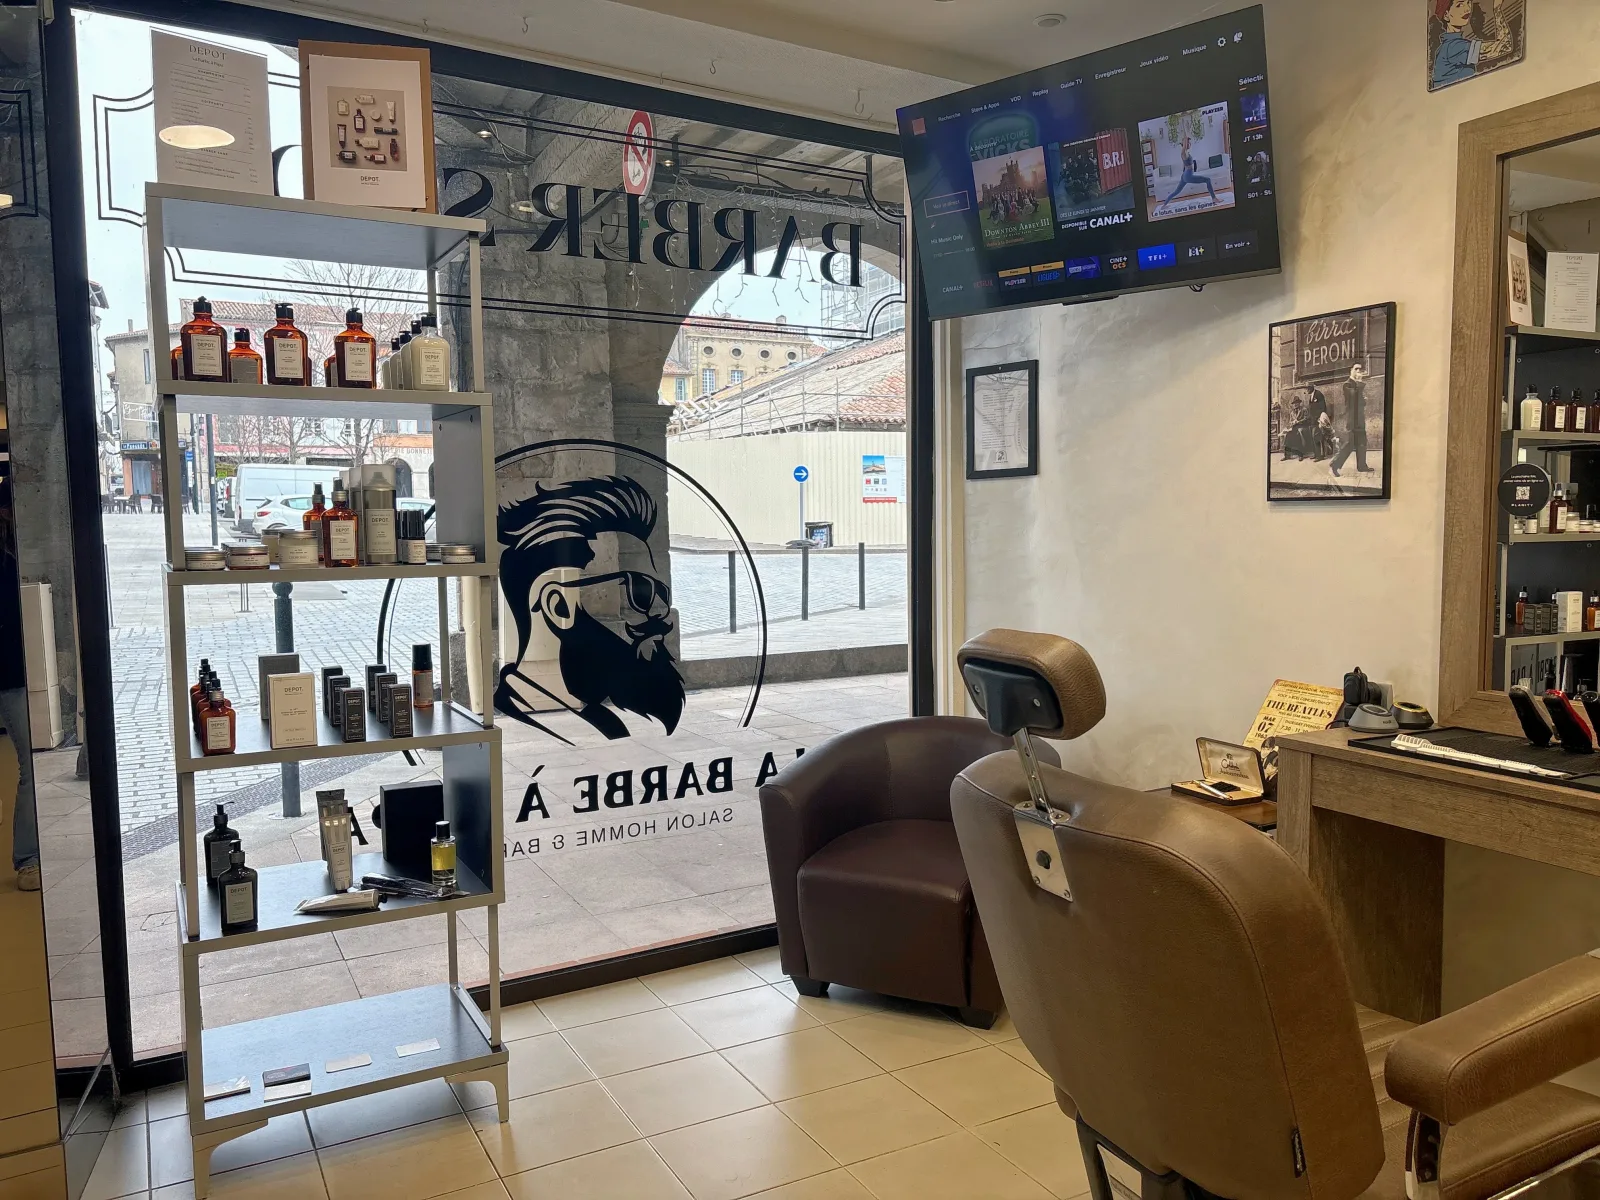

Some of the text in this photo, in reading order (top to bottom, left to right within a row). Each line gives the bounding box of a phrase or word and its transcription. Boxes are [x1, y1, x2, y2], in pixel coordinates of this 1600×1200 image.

[190, 44, 226, 60] DEPOT
[1182, 44, 1207, 56] Musique
[1140, 55, 1169, 68] Jeux vidéo
[1094, 66, 1127, 80] Enregistreur
[1060, 81, 1074, 90] Guide
[1032, 88, 1049, 97] Replay
[938, 112, 961, 122] Recherche
[974, 129, 1029, 146] LABORATOIRE
[1062, 220, 1087, 230] DISPONIBLE
[1090, 212, 1133, 229] CANAL+
[984, 226, 1017, 237] DOWNTON
[1019, 222, 1040, 231] ABBEY
[1040, 218, 1050, 227] III
[1148, 253, 1167, 262] TF1+
[943, 284, 963, 293] CANAL+
[1304, 338, 1356, 368] PERONI
[1266, 700, 1333, 718] THE BEATLES
[1257, 722, 1274, 733] 07
